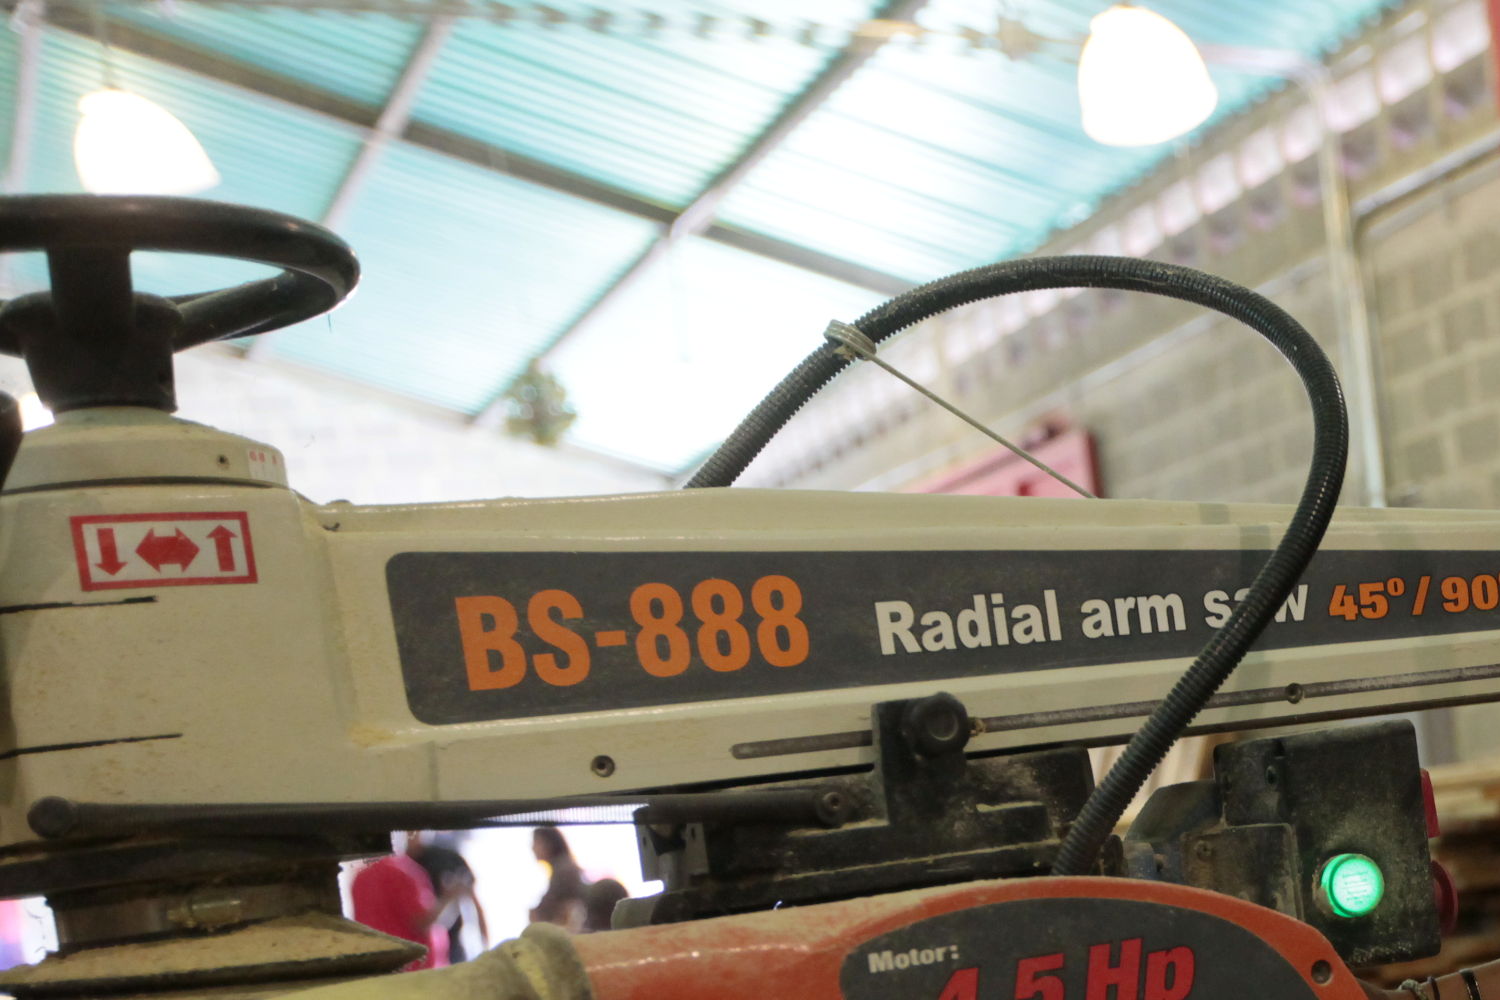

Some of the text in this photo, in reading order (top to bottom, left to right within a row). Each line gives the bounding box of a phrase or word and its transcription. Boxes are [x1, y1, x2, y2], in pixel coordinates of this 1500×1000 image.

[456, 575, 811, 692] BS-888
[874, 589, 1062, 656] Radial
[1080, 592, 1187, 639] arm
[868, 943, 960, 974] Motor:
